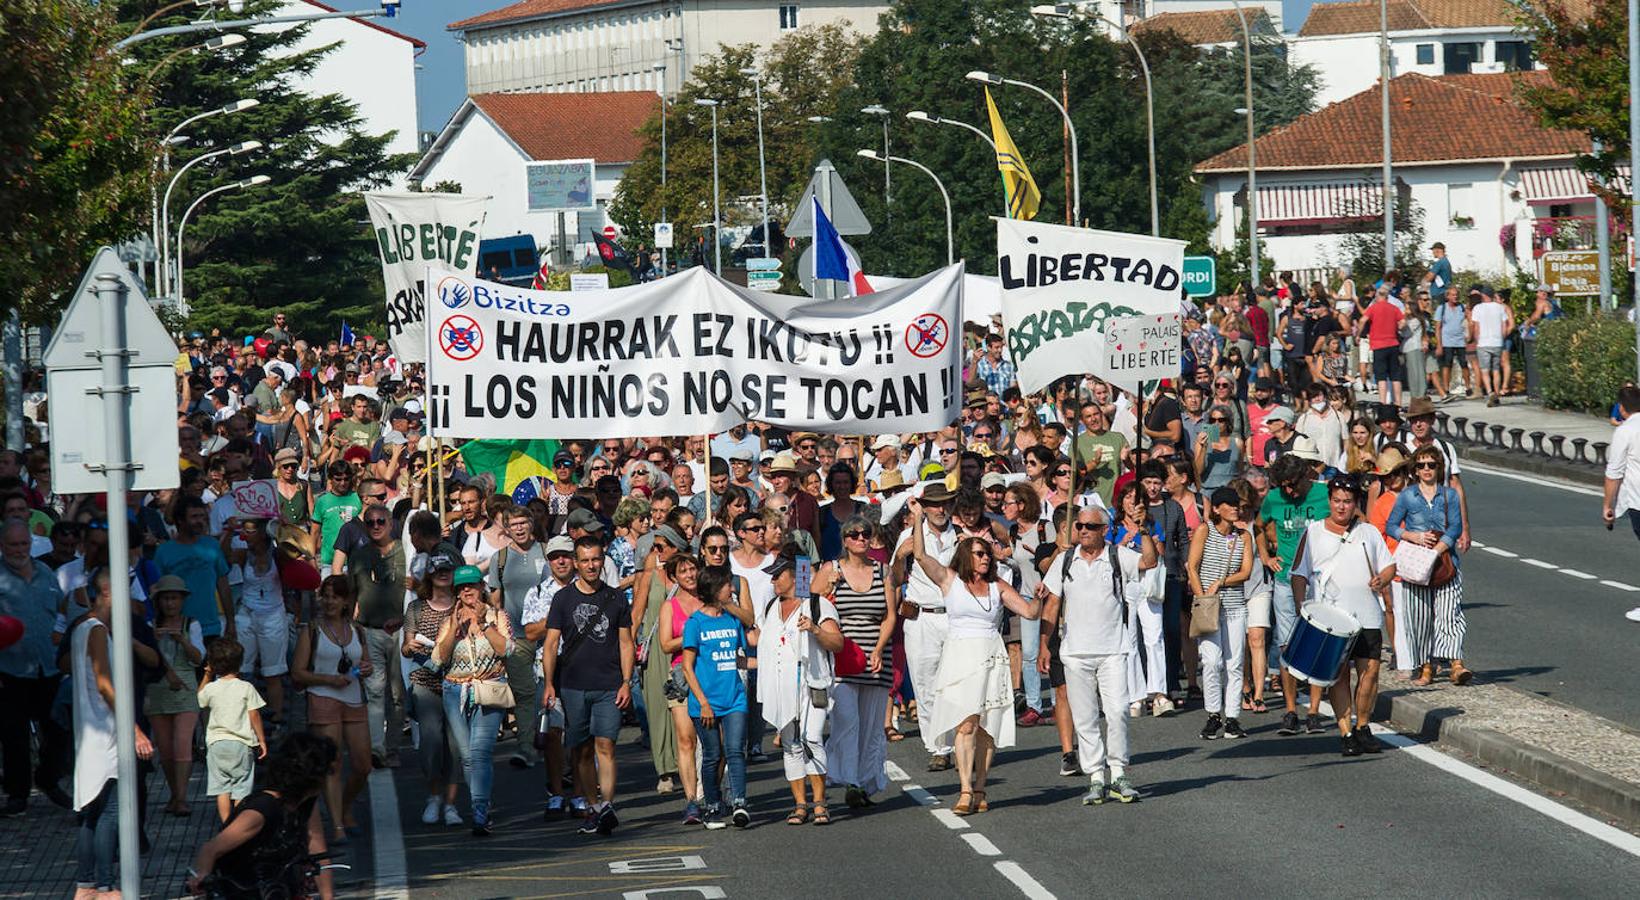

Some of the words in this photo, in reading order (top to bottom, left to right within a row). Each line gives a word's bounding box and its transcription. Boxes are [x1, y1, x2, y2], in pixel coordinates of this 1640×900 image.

[1000, 236, 1180, 291] LIBERTAD
[496, 314, 681, 364] HAURRAK
[693, 312, 734, 358] EZ
[872, 323, 894, 365] !!
[1141, 323, 1178, 341] PALAIS
[465, 374, 537, 419] LOS
[552, 364, 670, 419] NIÑOS
[683, 369, 733, 415] NO
[741, 373, 787, 419] SE
[800, 372, 929, 421] TOCAN
[700, 629, 737, 641] LIBERTA
[712, 650, 737, 661] SALU
